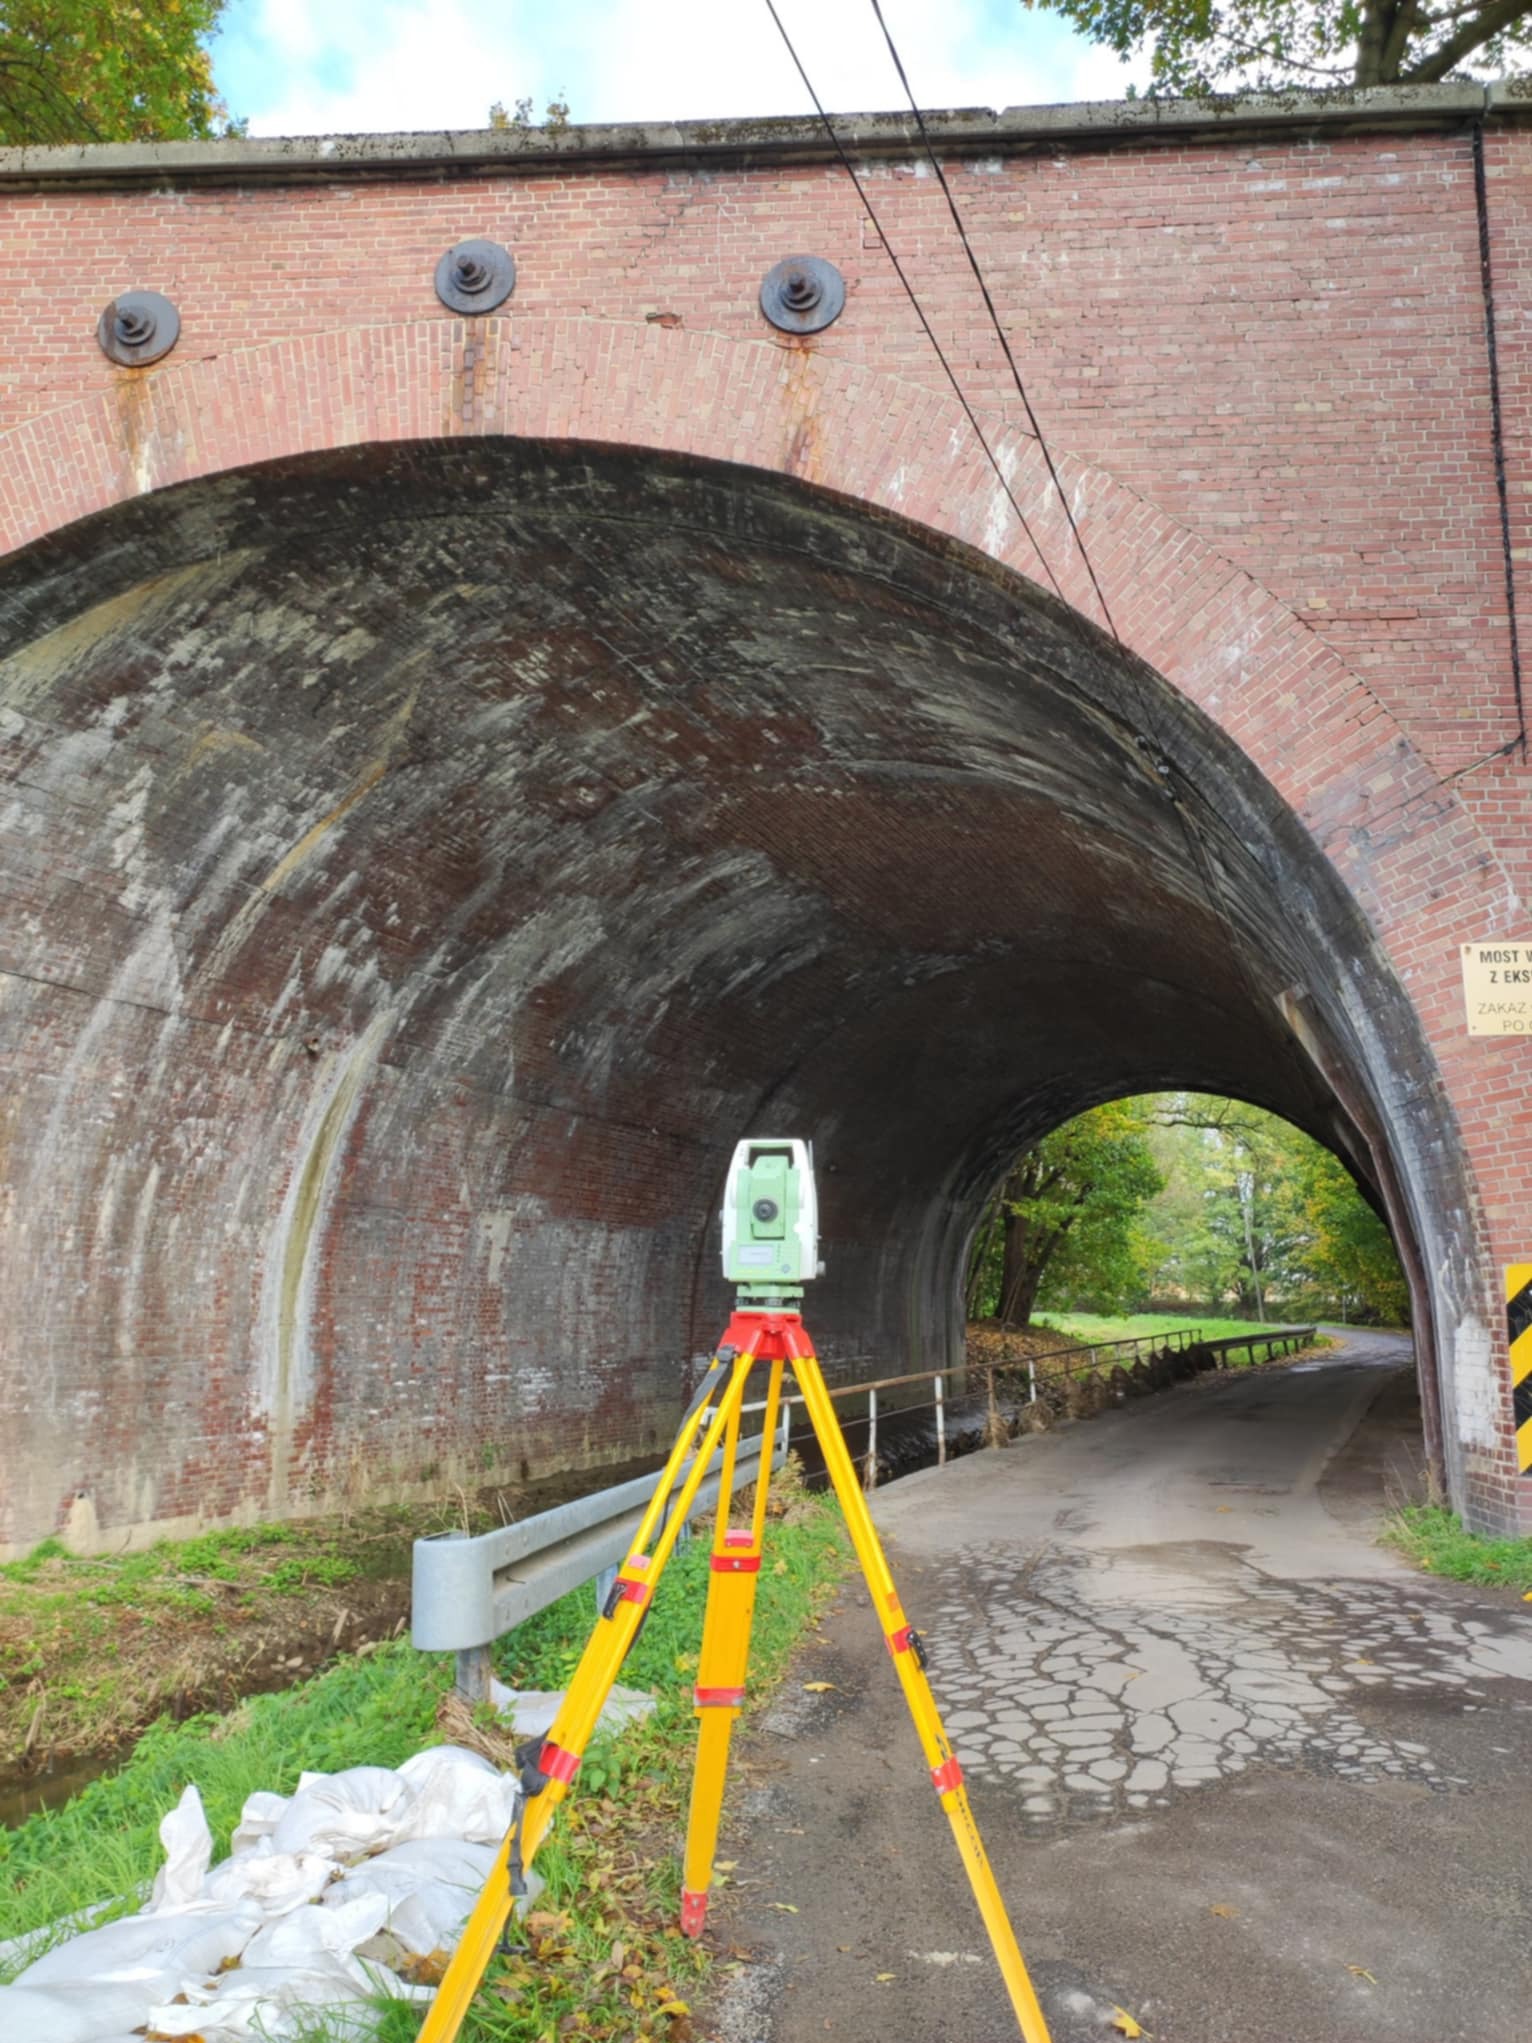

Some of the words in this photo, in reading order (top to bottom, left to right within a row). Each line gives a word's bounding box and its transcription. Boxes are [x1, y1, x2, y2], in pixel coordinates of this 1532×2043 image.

[1479, 950, 1520, 963] MOST
[1489, 970, 1499, 984] Z
[1477, 1001, 1527, 1015] ZAKAZ
[1502, 1019, 1525, 1032] PO
